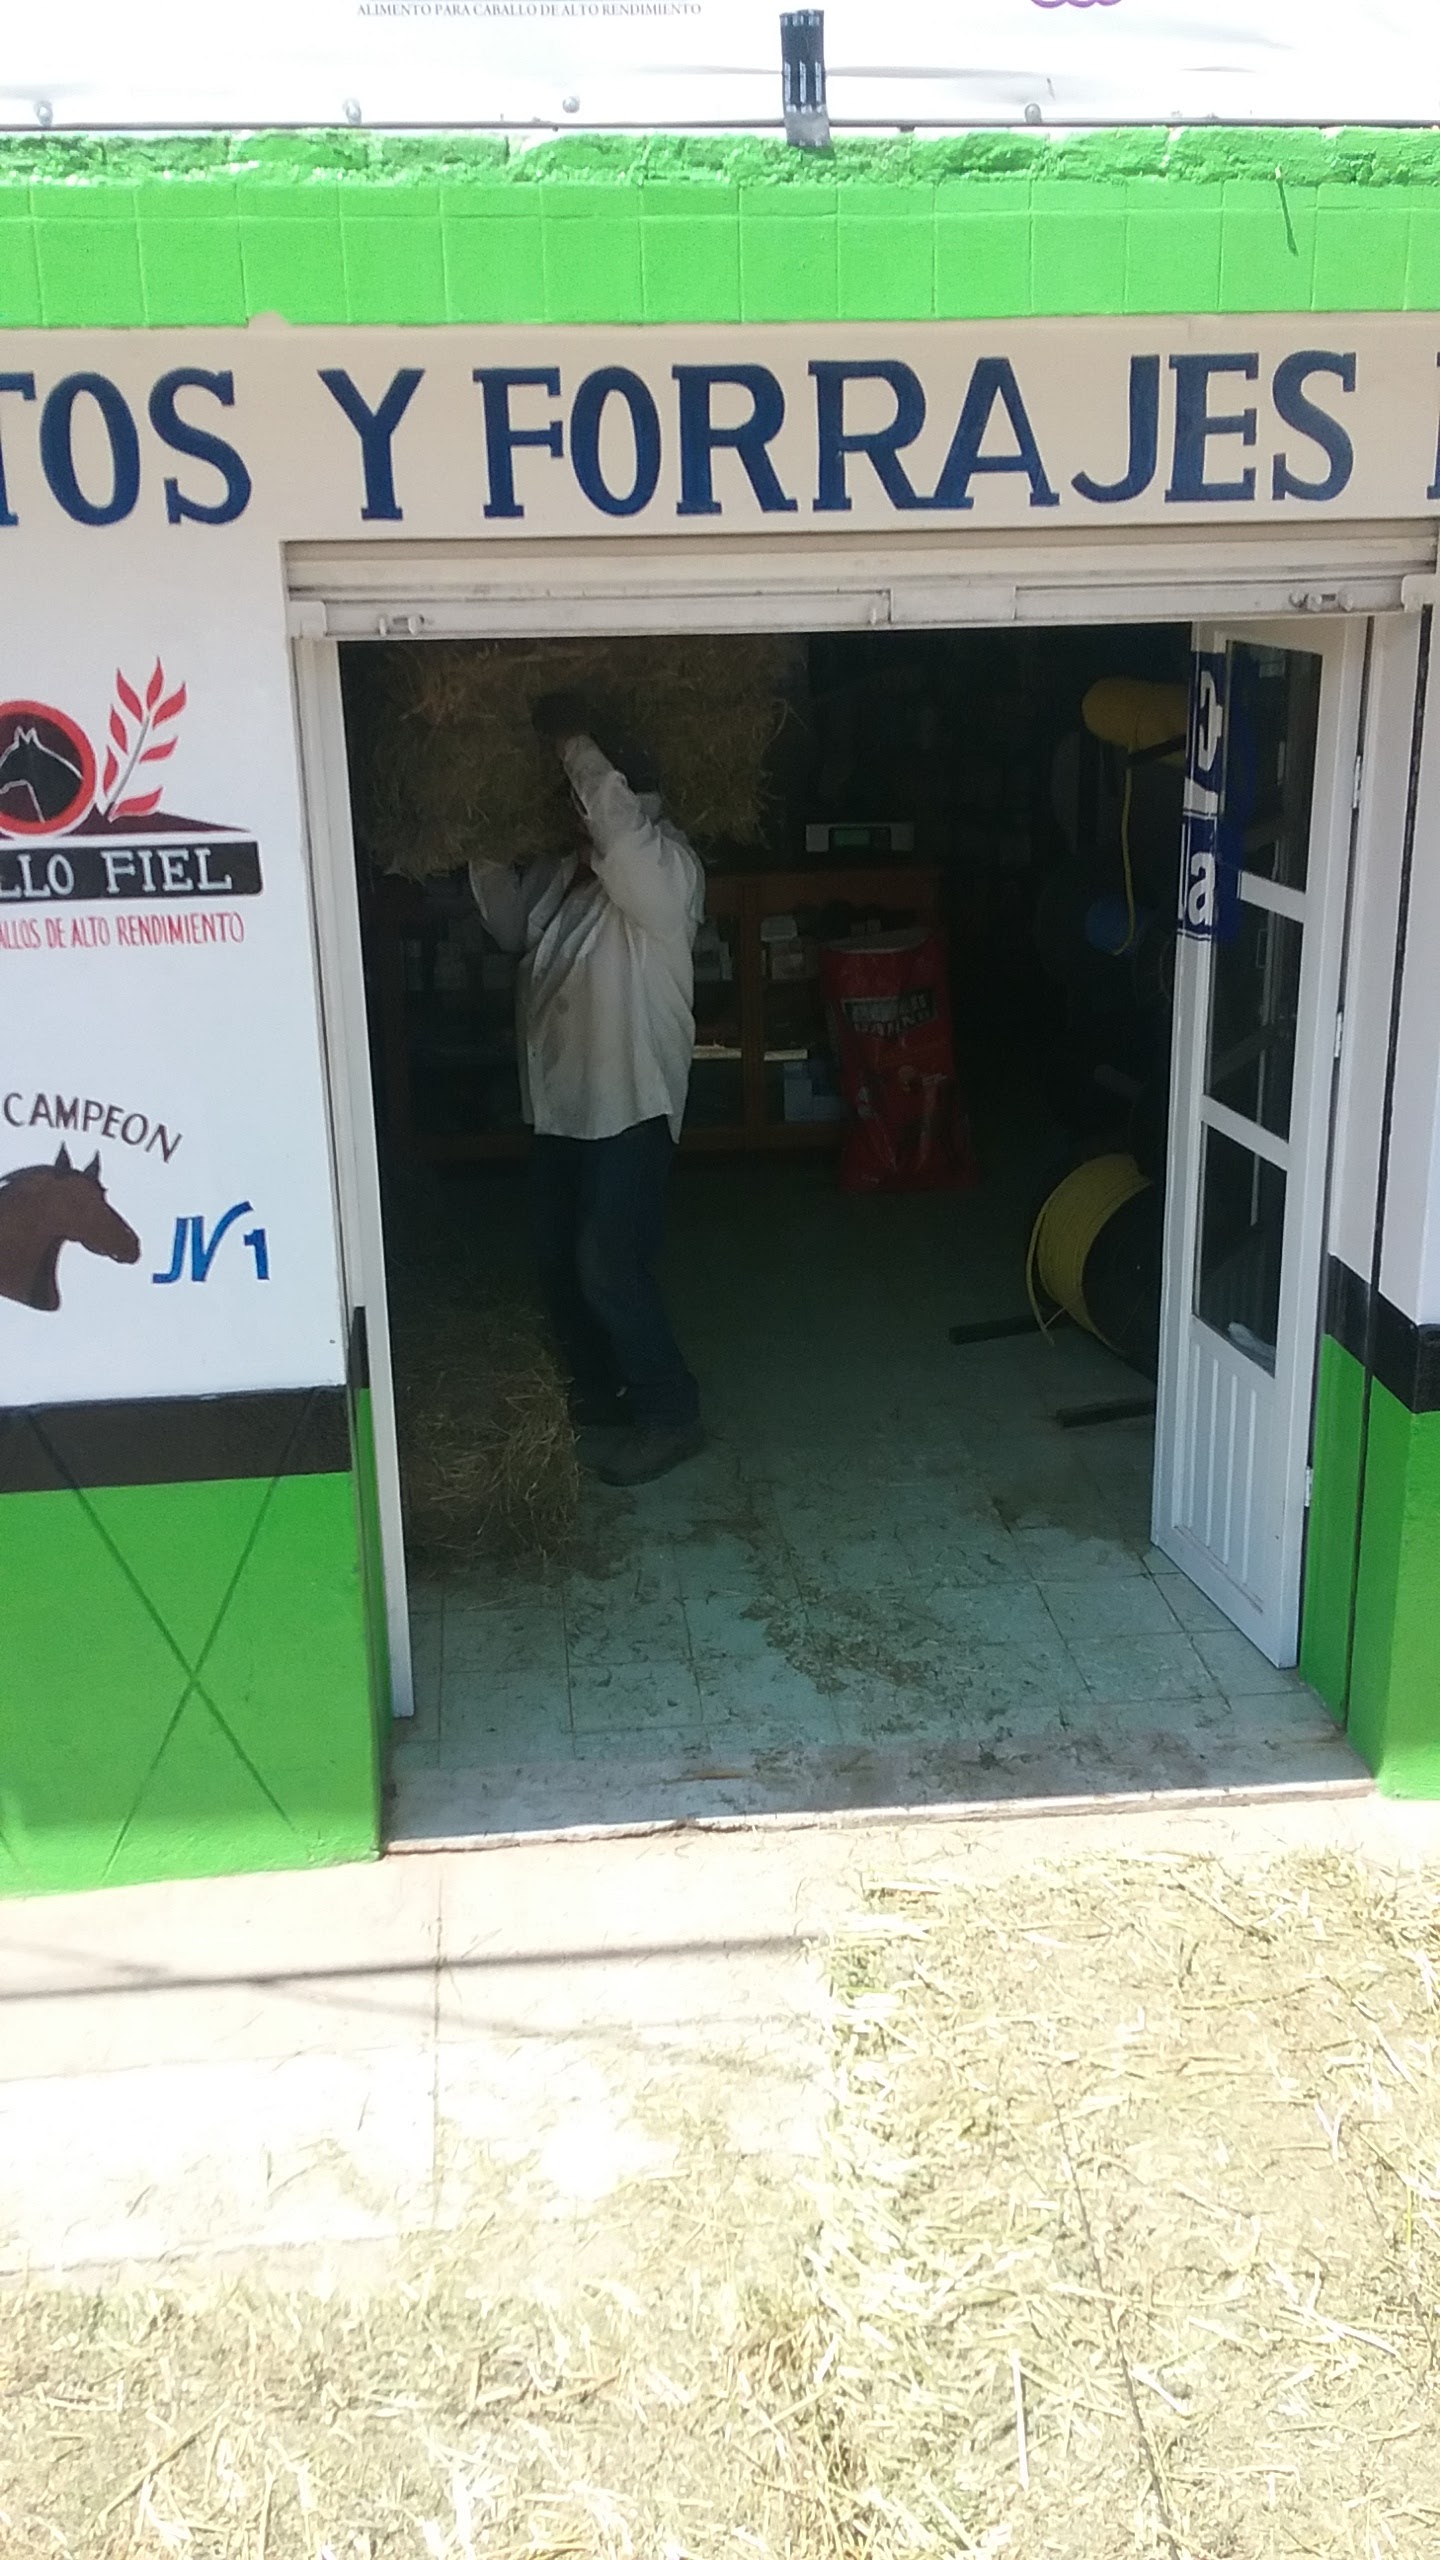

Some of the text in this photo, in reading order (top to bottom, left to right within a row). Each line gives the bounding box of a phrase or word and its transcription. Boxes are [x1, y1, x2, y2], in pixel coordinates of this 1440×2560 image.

[357, 2, 702, 17] ALIMENTO PARA CABALLO DE ALTO RENDIMIENTO
[317, 368, 425, 520] Y
[473, 350, 1356, 520] FORRAJES
[101, 848, 232, 894] FIEL
[45, 916, 67, 949] DE
[71, 916, 111, 948] ALTO
[116, 912, 245, 947] RENDIMIENTO
[3, 1092, 183, 1163] CAMPEON
